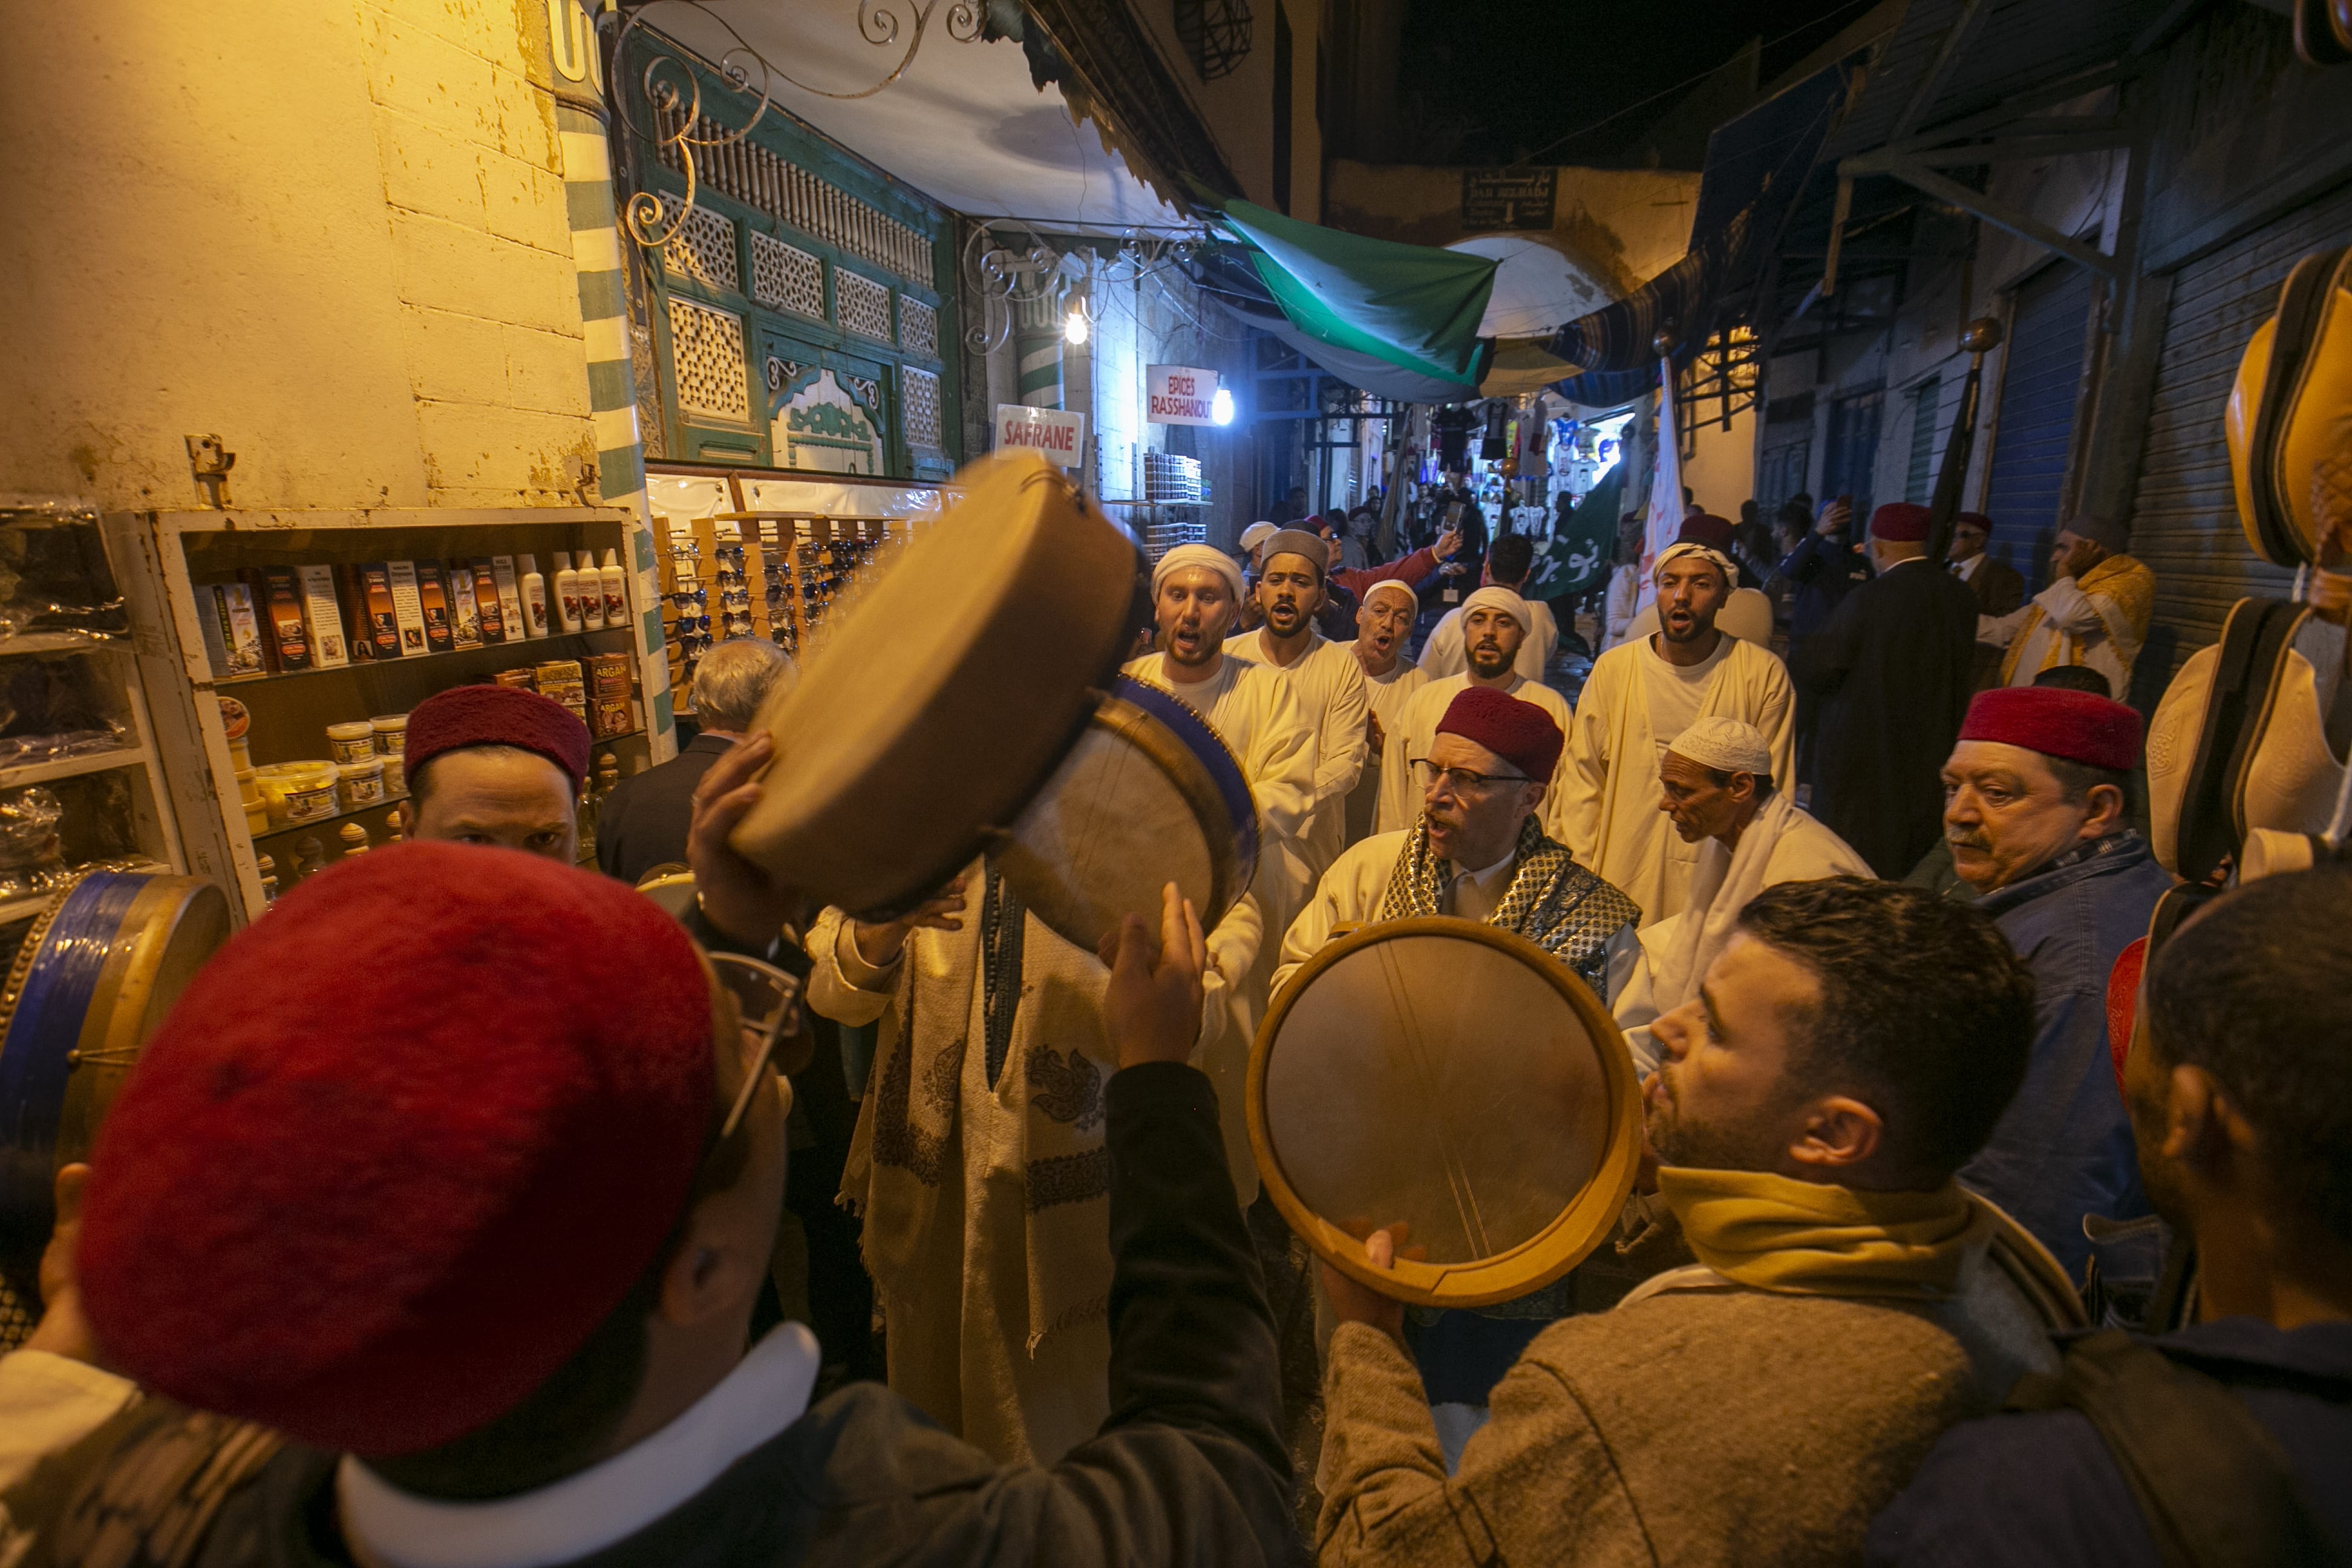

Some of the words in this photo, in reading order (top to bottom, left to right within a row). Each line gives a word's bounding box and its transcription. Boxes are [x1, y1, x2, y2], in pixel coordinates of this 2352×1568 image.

[1004, 419, 1075, 451] SAFRANE
[596, 665, 627, 678] ARGAN
[600, 702, 626, 713] ARGAN
